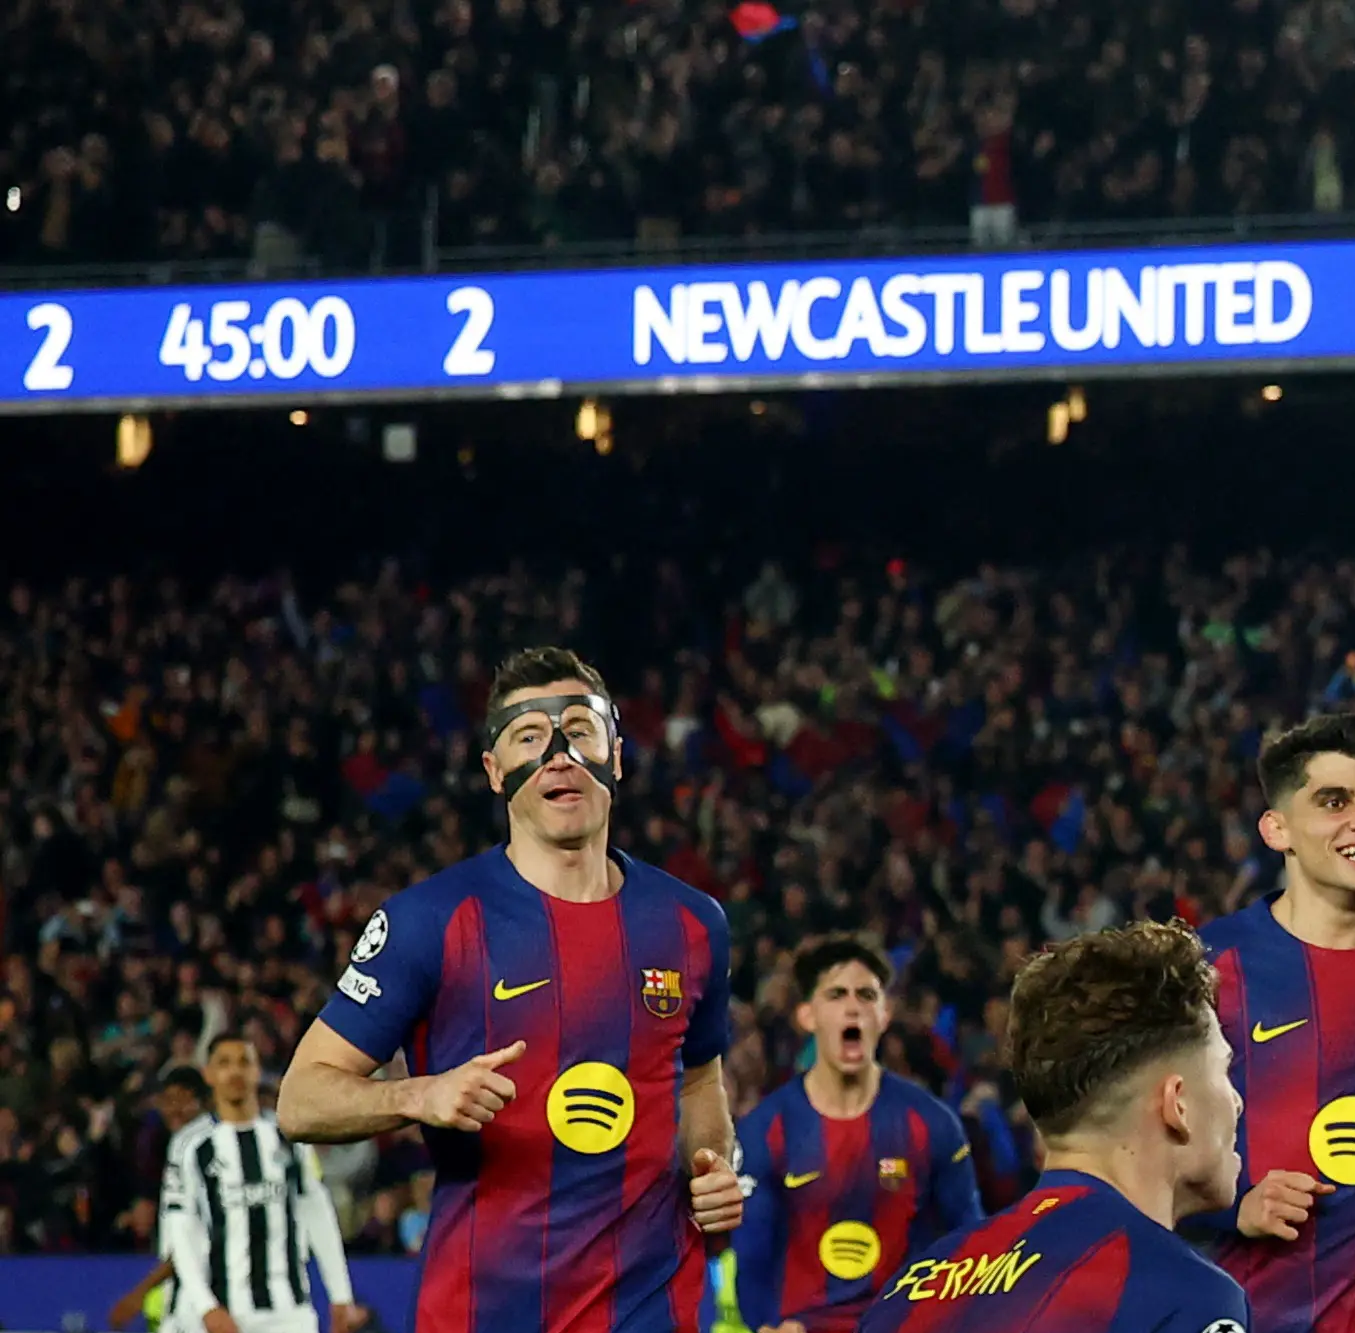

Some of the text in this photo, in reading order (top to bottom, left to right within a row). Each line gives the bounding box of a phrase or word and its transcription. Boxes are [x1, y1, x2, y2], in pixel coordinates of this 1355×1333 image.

[24, 303, 73, 391] 2
[159, 296, 355, 381] 45:00
[443, 287, 496, 376] 2
[883, 1239, 1042, 1300] FERMÍN
